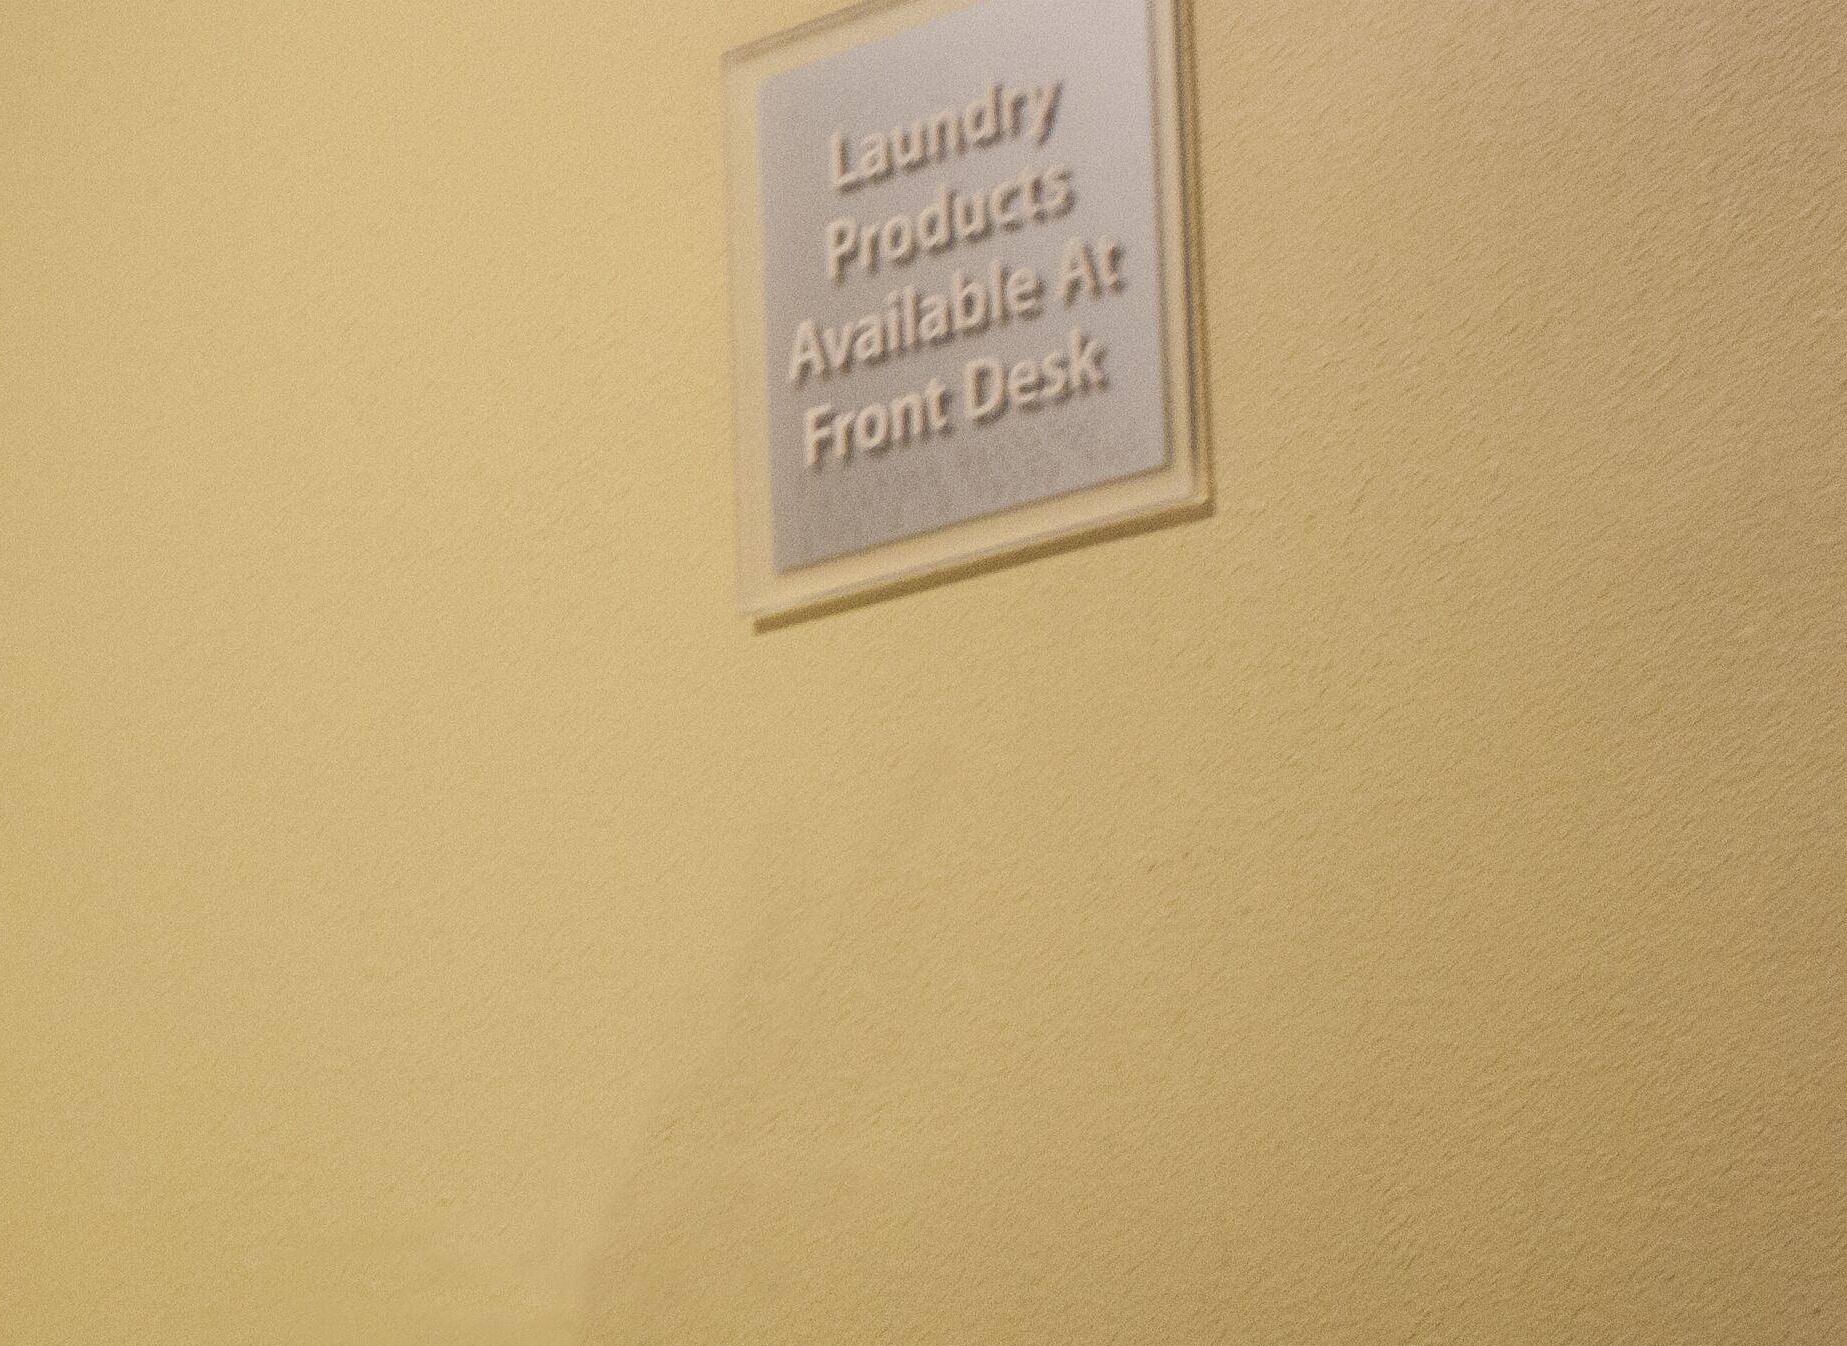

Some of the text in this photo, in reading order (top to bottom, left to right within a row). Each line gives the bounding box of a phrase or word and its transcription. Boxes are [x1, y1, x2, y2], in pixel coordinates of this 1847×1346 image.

[829, 78, 1063, 192] Laundry
[825, 165, 1073, 285] Products
[788, 234, 1127, 385] Available At
[804, 328, 1110, 470] Front Desk
